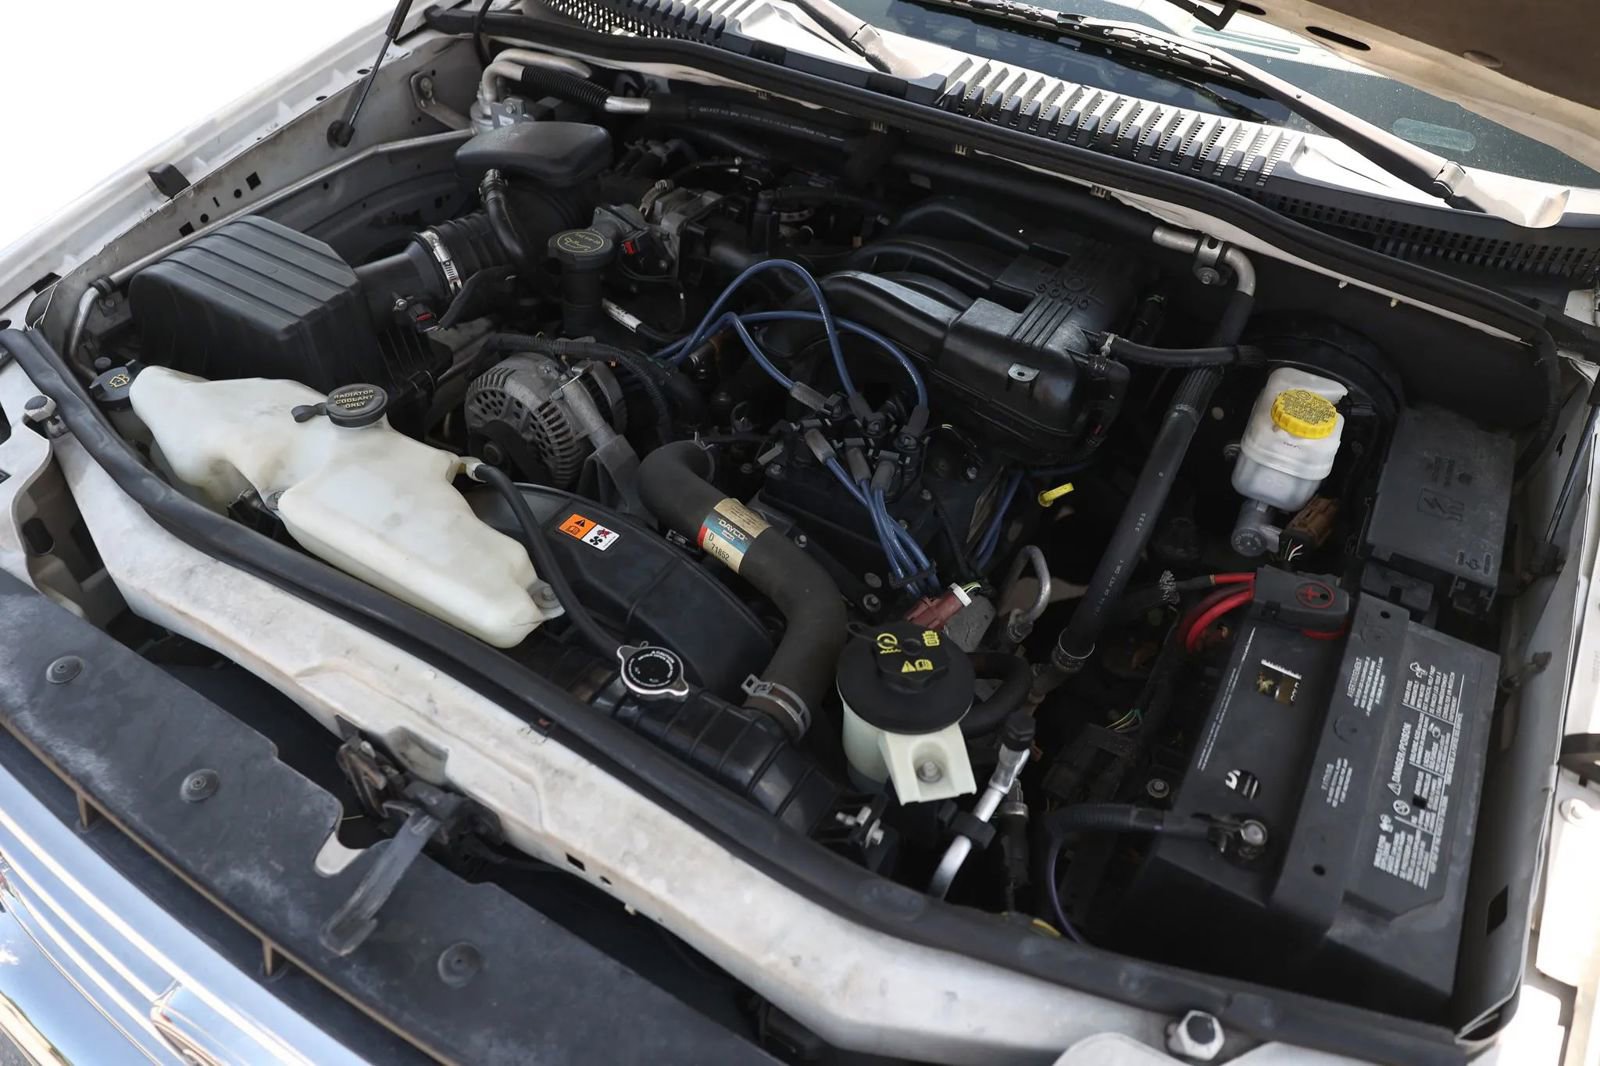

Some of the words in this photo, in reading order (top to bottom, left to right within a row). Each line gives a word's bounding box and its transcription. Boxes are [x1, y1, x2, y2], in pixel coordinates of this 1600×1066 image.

[1034, 281, 1089, 311] SOHC
[333, 389, 374, 399] RADIATOR
[335, 395, 374, 405] COOLANT
[345, 401, 366, 409] ONLY
[718, 519, 746, 541] DAYCO
[711, 543, 730, 561] 71852
